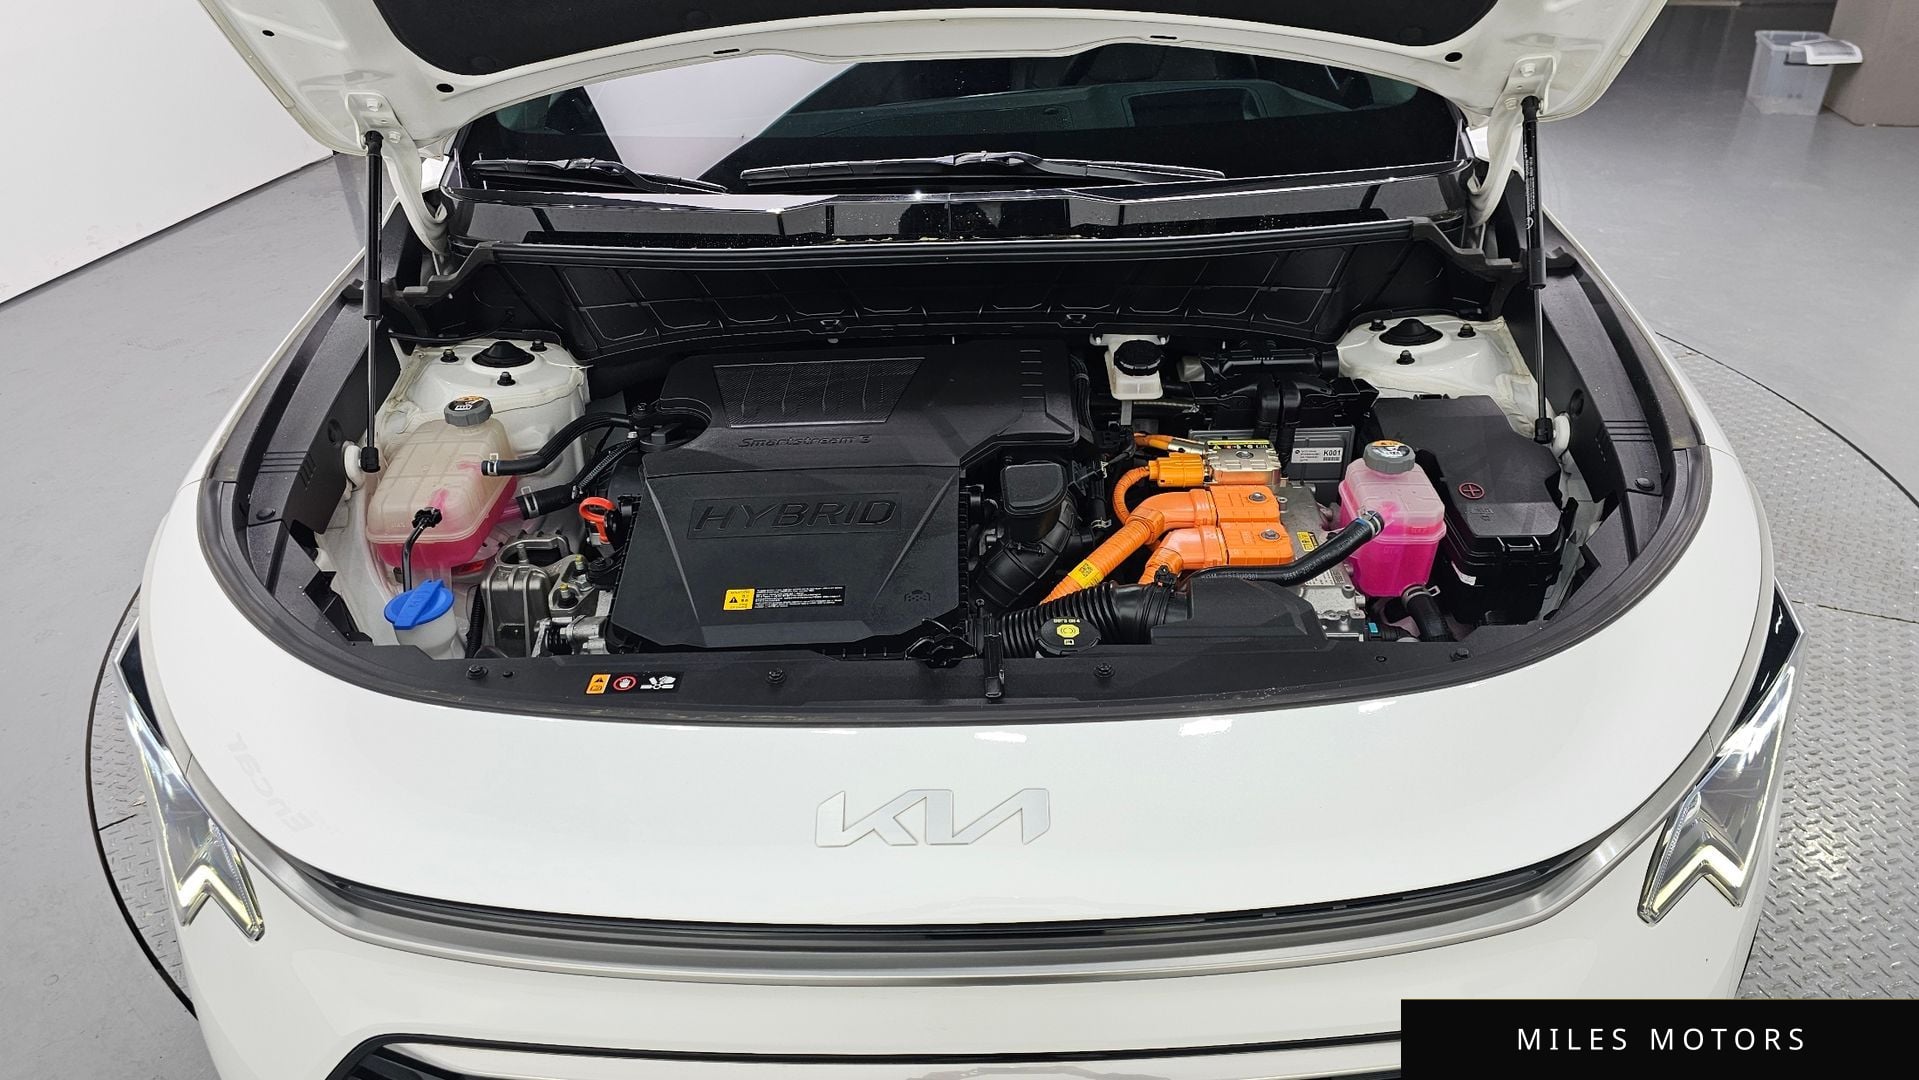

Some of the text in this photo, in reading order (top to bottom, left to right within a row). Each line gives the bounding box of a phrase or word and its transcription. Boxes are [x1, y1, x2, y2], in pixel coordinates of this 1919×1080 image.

[738, 435, 858, 449] Smartstream
[1323, 449, 1341, 457] K001
[693, 500, 897, 531] HYBRID
[815, 788, 1051, 848] KIA
